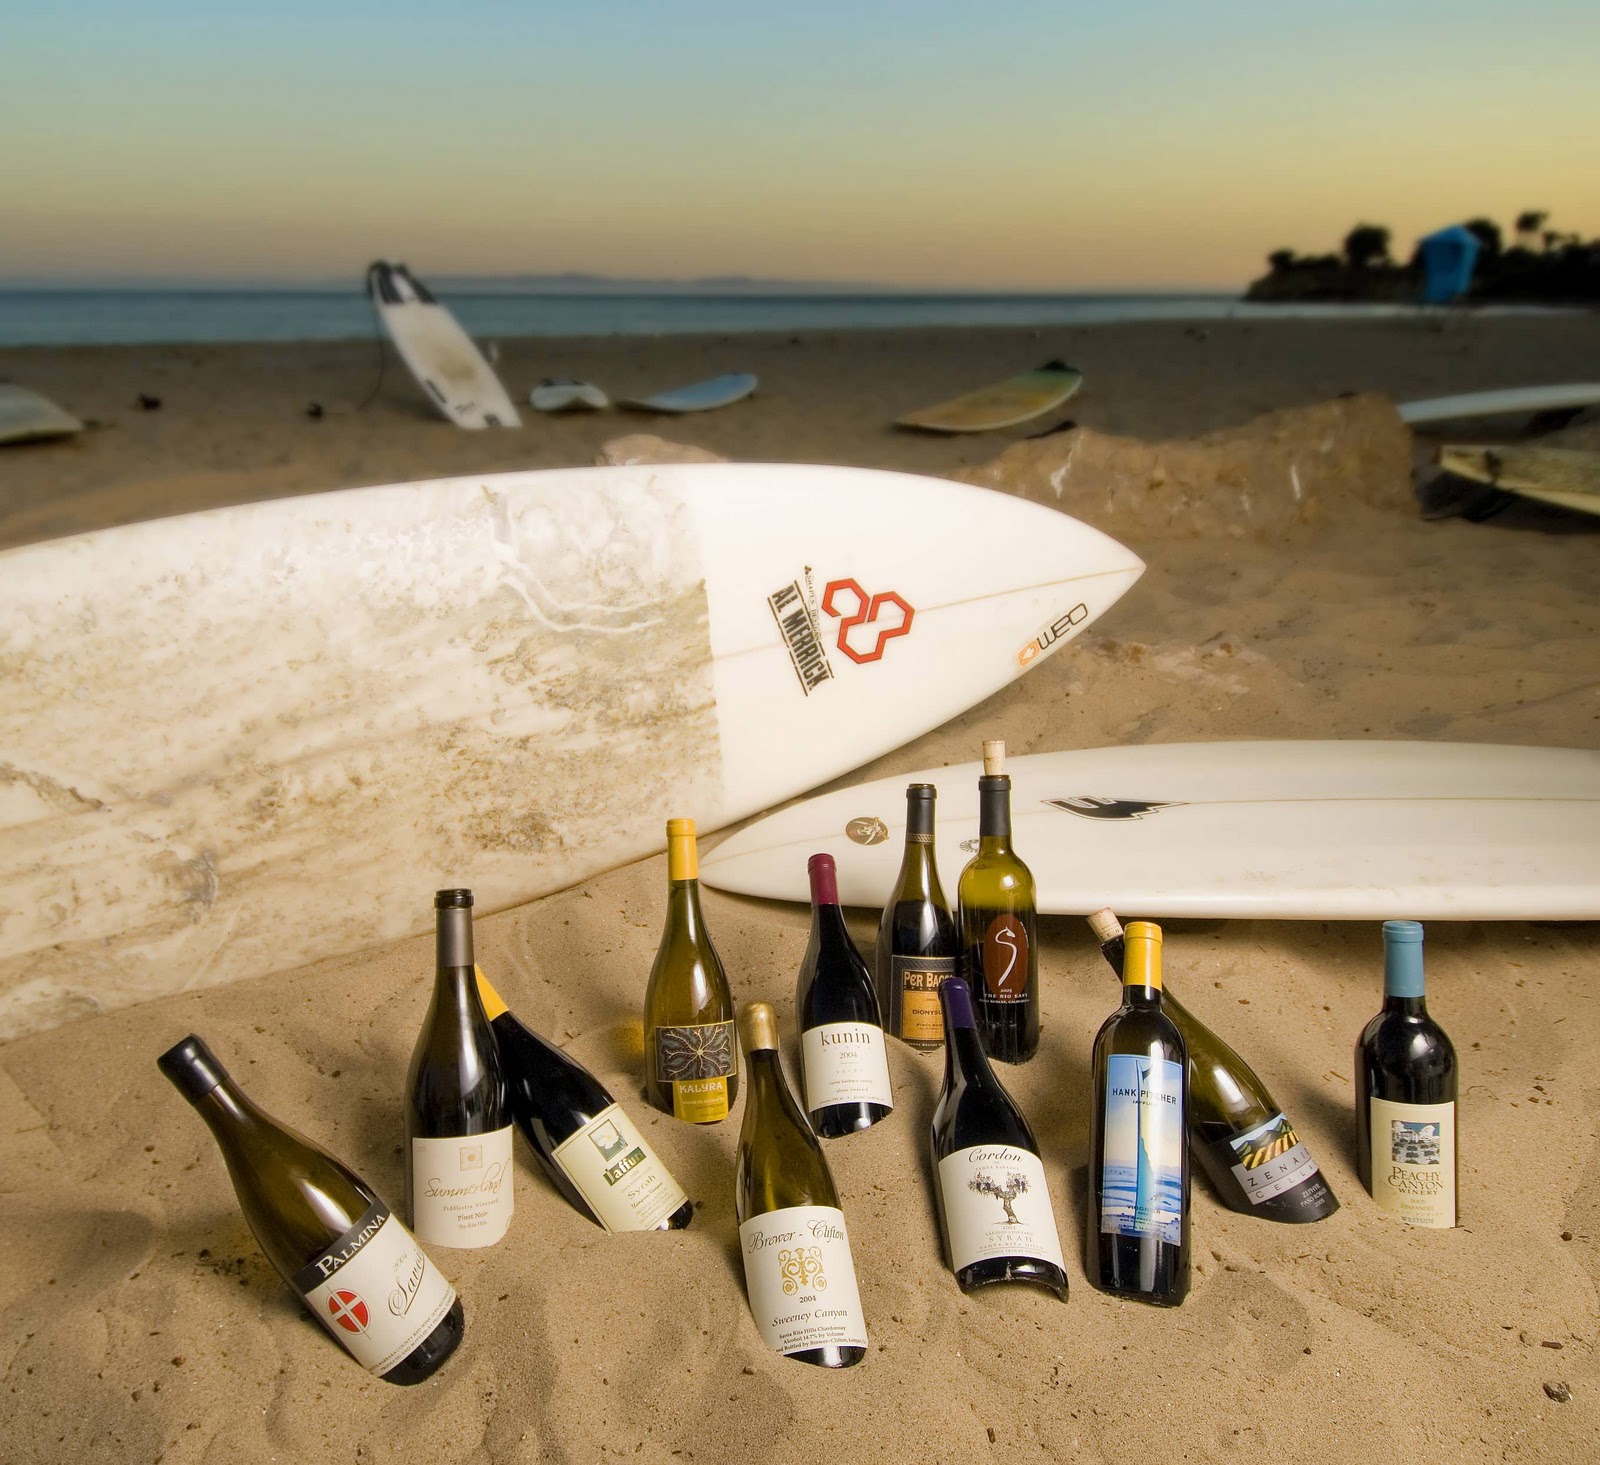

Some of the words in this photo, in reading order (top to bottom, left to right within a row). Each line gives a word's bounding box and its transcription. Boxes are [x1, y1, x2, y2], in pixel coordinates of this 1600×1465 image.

[772, 584, 798, 613] AL
[782, 608, 829, 691] MERRICK
[820, 1028, 870, 1046] kunin
[679, 1082, 723, 1094] KALYRA
[1112, 1088, 1137, 1097] HANK
[968, 1148, 1023, 1163] Cordon
[1392, 1166, 1440, 1181] PEACHY
[627, 1175, 656, 1200] Syrah
[1388, 1175, 1443, 1190] CANYON
[1398, 1188, 1438, 1196] WINERY
[457, 1214, 473, 1222] Pinot
[474, 1211, 488, 1219] Noir
[748, 1231, 796, 1254] Brewer
[807, 1220, 844, 1243] Clifton
[989, 1235, 1032, 1243] SYRAH
[315, 1214, 385, 1278] PALMINA
[799, 1295, 816, 1304] 2004
[771, 1312, 811, 1327] Sweeney
[814, 1309, 848, 1320] Canyon
